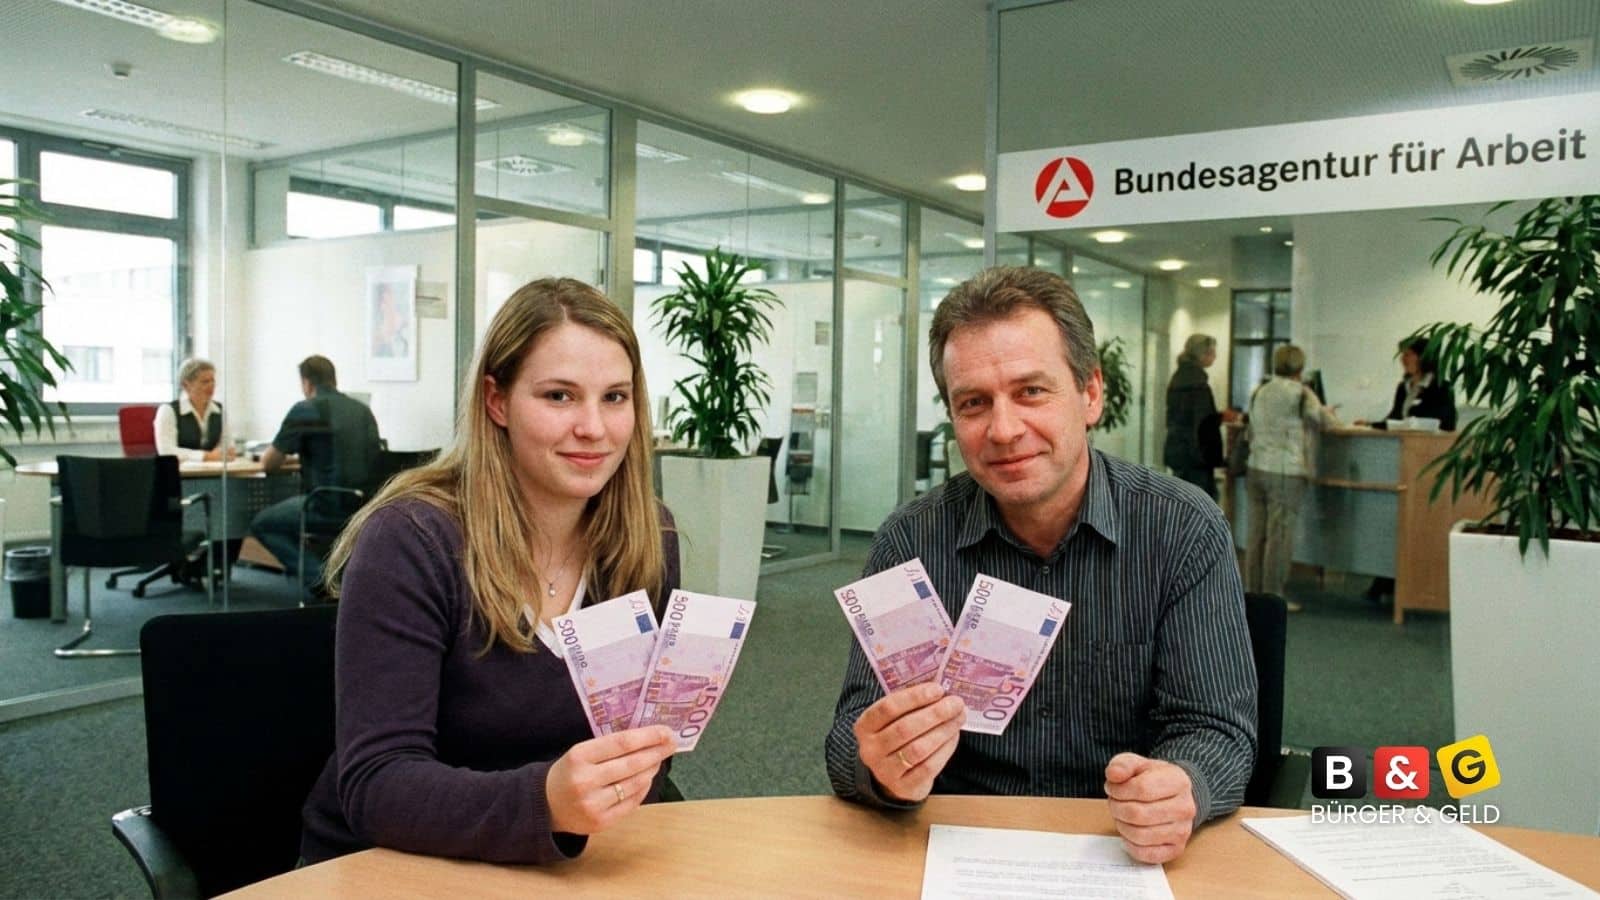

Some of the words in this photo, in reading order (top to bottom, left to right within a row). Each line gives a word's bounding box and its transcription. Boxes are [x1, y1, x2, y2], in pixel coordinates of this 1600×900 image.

[1114, 153, 1379, 197] Bundesagentur
[1389, 143, 1446, 175] für
[1456, 128, 1587, 169] Arbeit
[670, 595, 689, 622] 500
[973, 579, 994, 606] 500
[557, 618, 579, 646] 500
[679, 694, 716, 739] 500
[983, 679, 1025, 721] 500
